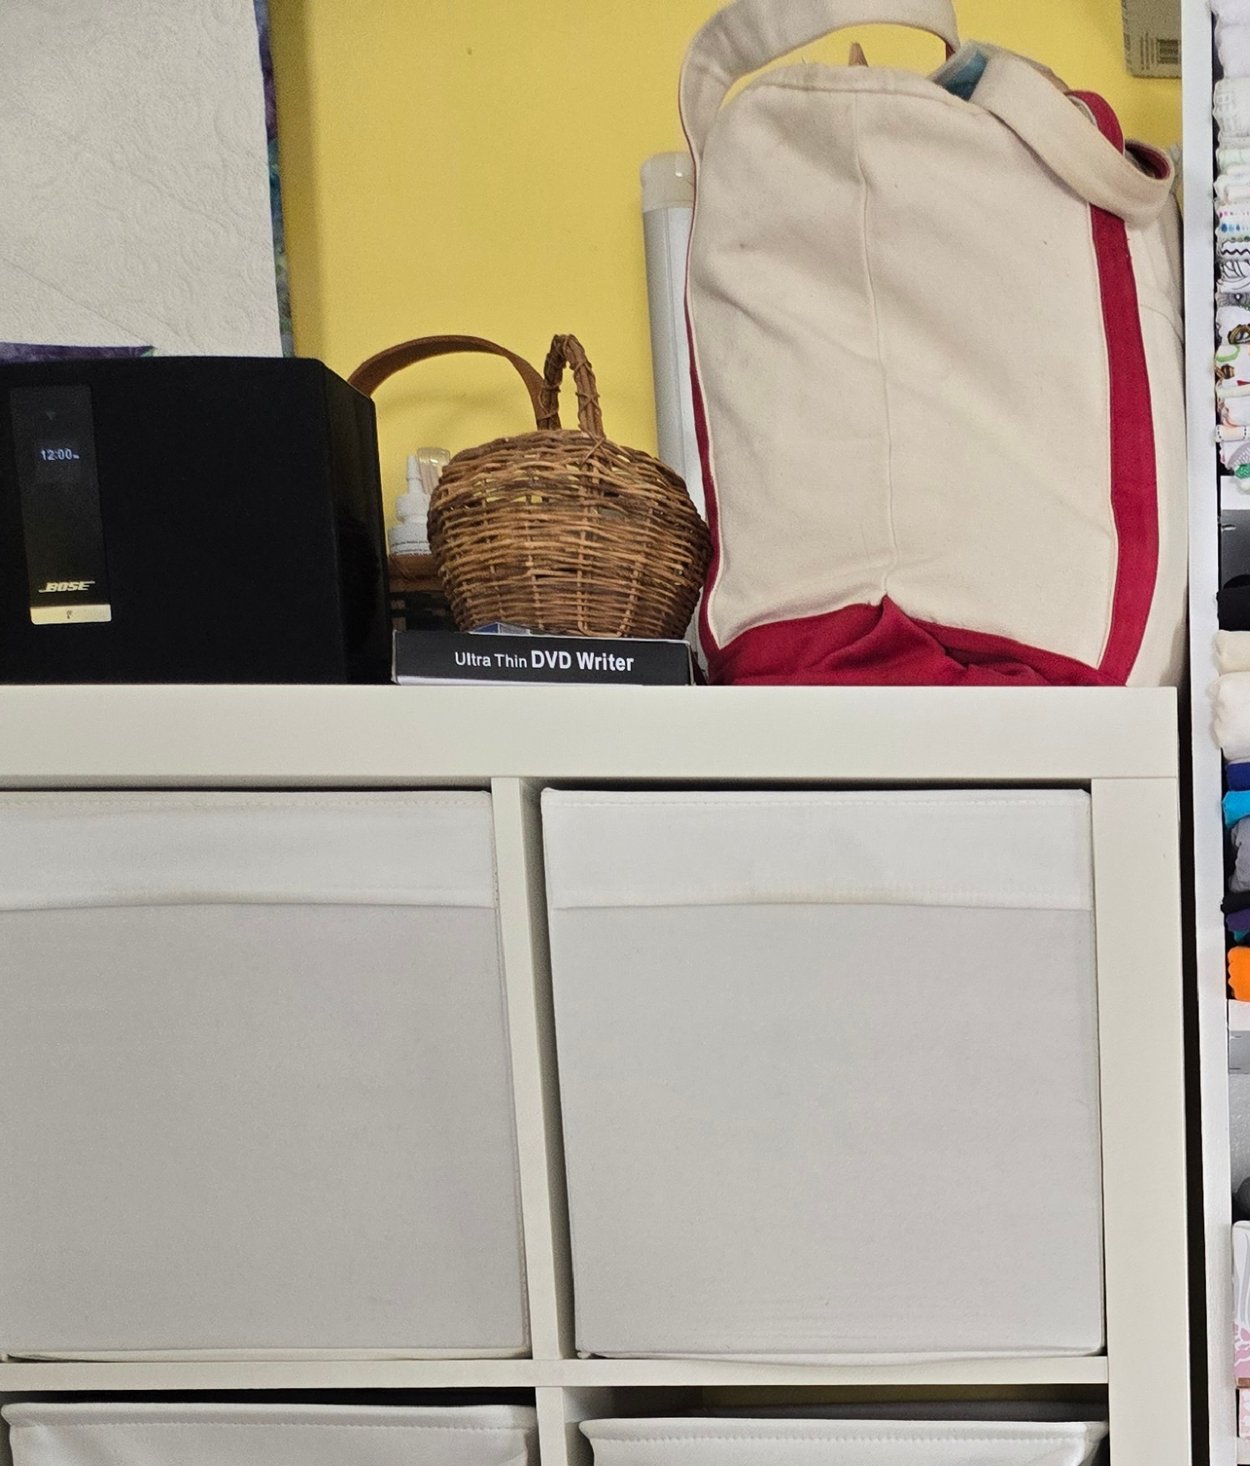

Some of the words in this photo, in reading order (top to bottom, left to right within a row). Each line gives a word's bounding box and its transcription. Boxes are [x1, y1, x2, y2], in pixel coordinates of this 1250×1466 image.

[41, 448, 72, 461] 12:00
[39, 580, 96, 593] BOSE
[455, 651, 491, 667] Ultra
[494, 653, 528, 668] Thin
[531, 650, 572, 669] DVD
[576, 652, 635, 671] Writer
